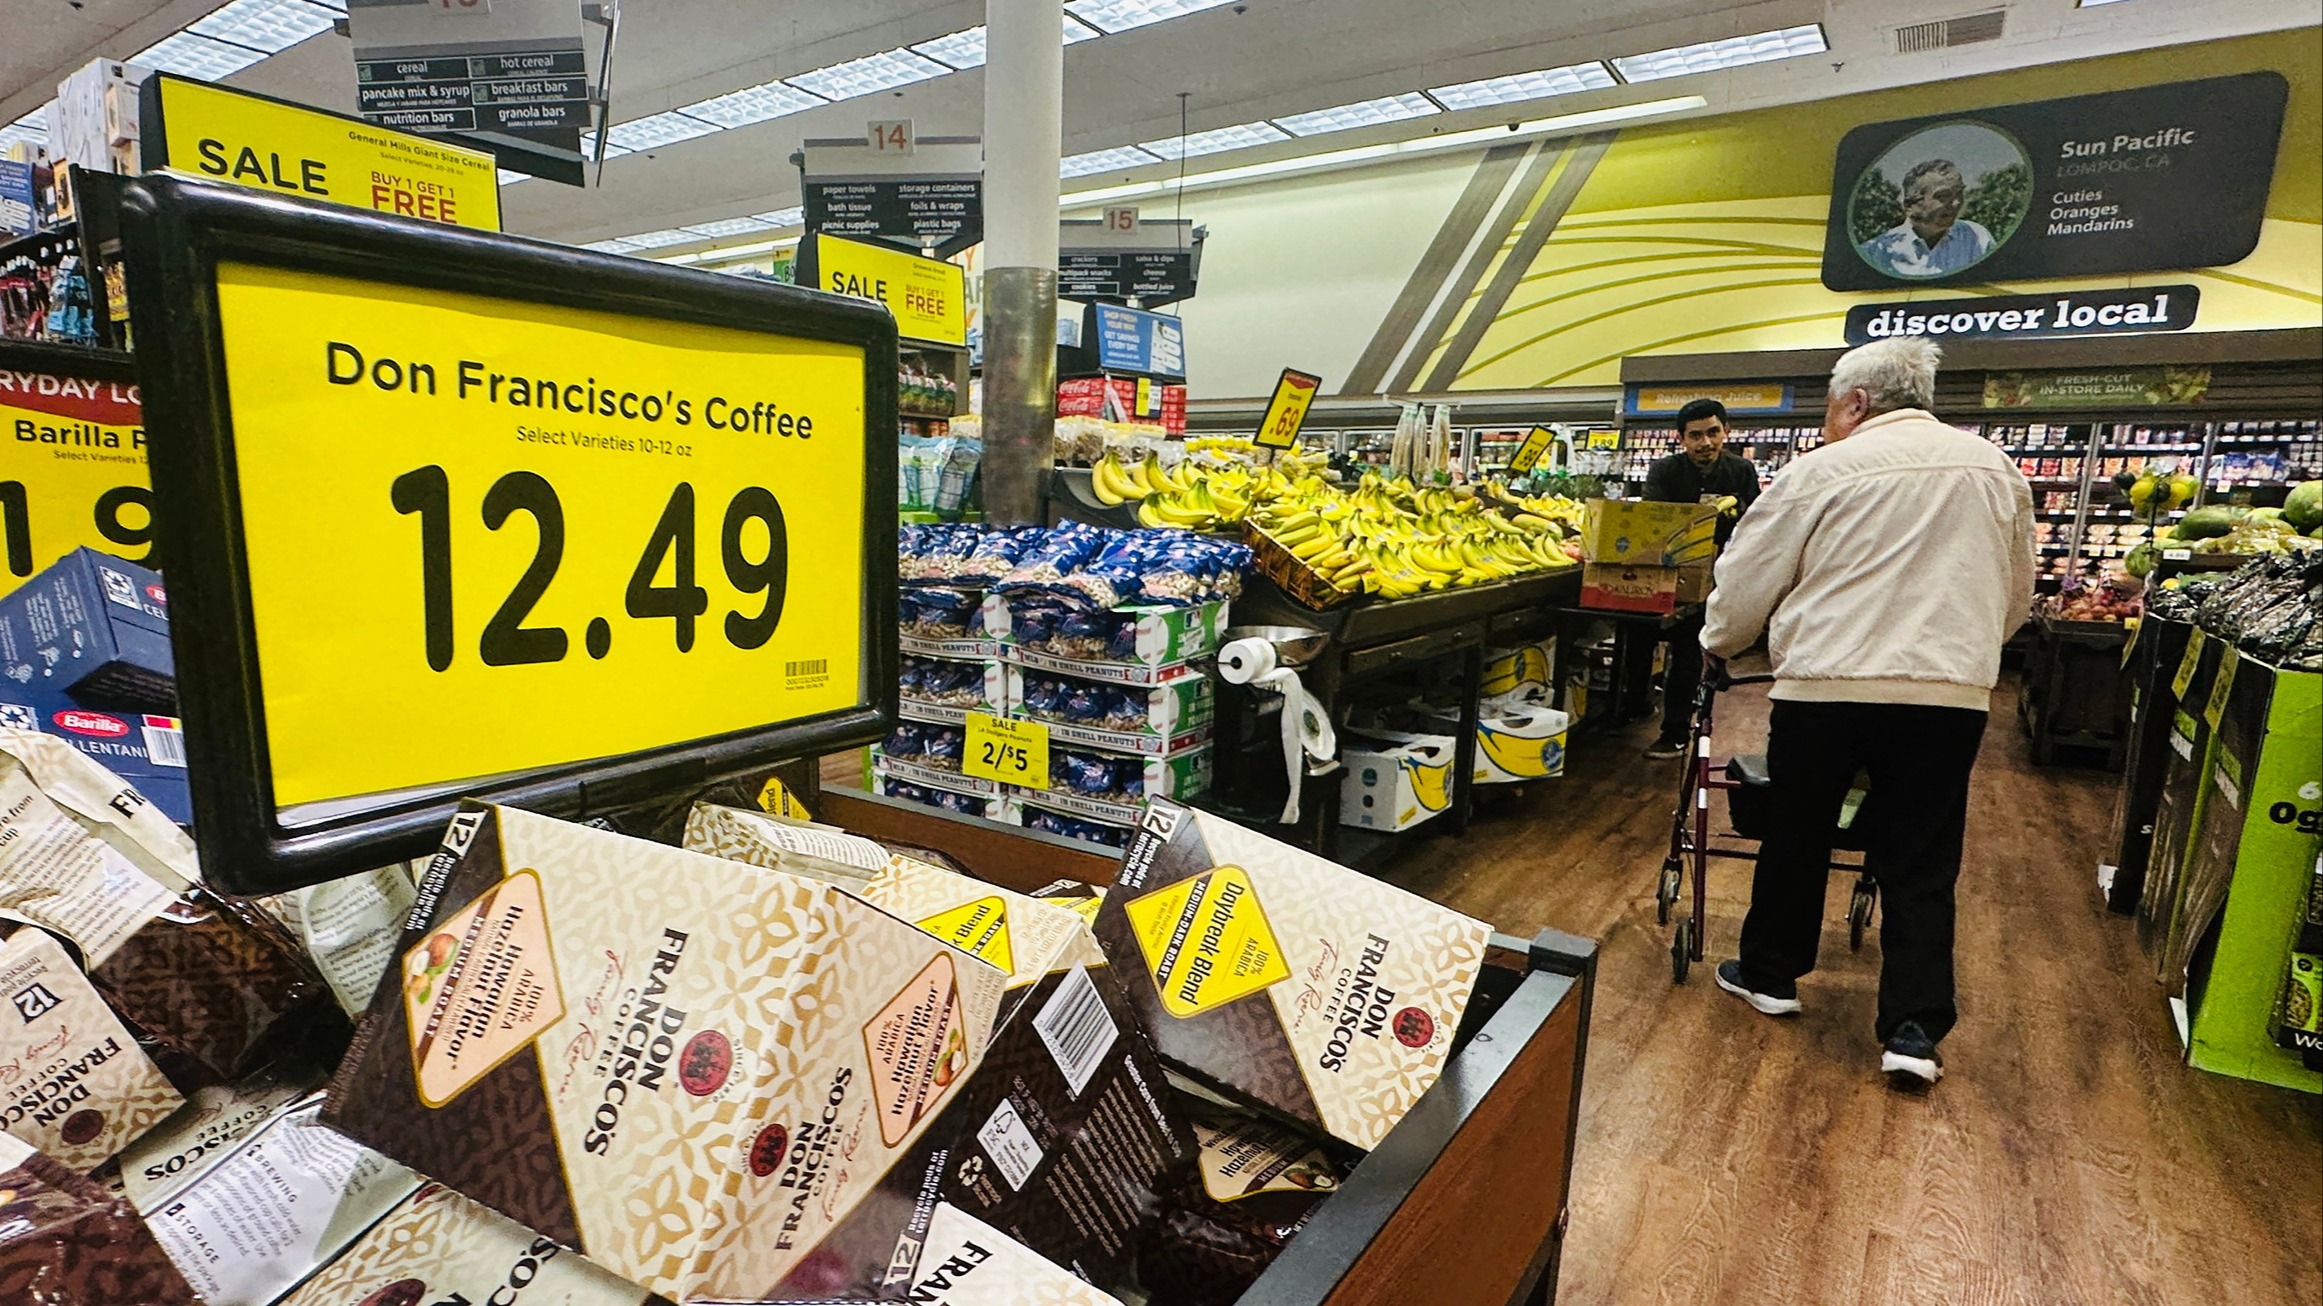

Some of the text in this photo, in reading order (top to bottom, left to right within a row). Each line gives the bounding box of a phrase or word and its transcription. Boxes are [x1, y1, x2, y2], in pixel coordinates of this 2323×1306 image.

[396, 60, 429, 74] cereal
[500, 54, 555, 69] hot cereal
[362, 85, 471, 102] pancake mix & syrup
[491, 80, 569, 95] breakfast bars
[383, 110, 455, 125] nutrition bars
[498, 105, 566, 122] granola bars
[348, 131, 490, 171] General Mills Giant Size Cereal
[873, 123, 907, 150] 14
[2060, 127, 2196, 158] Sun Pacific
[198, 138, 330, 196] SALE
[380, 151, 402, 162] Select
[2144, 154, 2171, 172] CA
[371, 171, 455, 199] BUY 1 GET 1
[822, 186, 847, 197] paper
[848, 184, 876, 194] towels
[898, 183, 975, 194] storage containers
[2052, 188, 2103, 205] Cuties
[371, 185, 458, 224] FREE
[827, 202, 873, 213] bath tissue
[910, 201, 965, 212] foils wraps
[2049, 202, 2119, 221] Oranges
[821, 219, 880, 231] picnic supplies
[913, 219, 962, 231] plastic bags
[1108, 210, 1133, 231] 15
[2047, 217, 2135, 236] Mandarins
[832, 271, 887, 302] SALE
[905, 284, 940, 298] BUY GET
[905, 293, 945, 316] FREE
[1866, 294, 2169, 338] discover local
[325, 340, 814, 441] Don Francisco's Coffee
[2039, 383, 2146, 395] IN-STORE DAILY
[2056, 373, 2133, 385] FRESH-CUT
[1724, 390, 1763, 402] Juice
[14, 419, 120, 449] Barilla
[1268, 406, 1300, 437] .69
[516, 424, 693, 457] Select Varieties 10-12 oz
[54, 449, 137, 465] Select Varieties
[390, 463, 789, 673] 12.49
[942, 644, 976, 653] PEANUTS
[1059, 661, 1084, 674] SHELL
[1085, 666, 1124, 678] PEANUTS
[64, 714, 123, 735] Barilla
[991, 718, 1017, 732] SALE
[1072, 730, 1136, 748] SHELL PEANUTS
[981, 741, 1029, 772] 2/$5
[920, 769, 973, 787] SHELL PEANUTS
[8, 793, 35, 818] from
[1069, 798, 1132, 820] SHELL PEANUTS
[446, 816, 478, 848] 12
[1149, 807, 1177, 840] 12
[1142, 837, 1162, 866] Recycle
[955, 903, 992, 940] Blend
[449, 914, 486, 980] MEDIUM
[475, 904, 525, 992] Hazelnut
[1178, 880, 1246, 1006] Daybreak Blend
[1233, 936, 1260, 979] ARABICA
[1157, 944, 1180, 980] ROAST
[1250, 949, 1270, 977] 100%
[15, 986, 57, 1018] 12
[471, 943, 524, 1040] Hawaiian
[500, 967, 536, 1031] ARABICA
[518, 983, 545, 1024] 100%
[1319, 932, 1391, 1074] FRANCISCO'S
[1322, 967, 1352, 1024] COFFEE
[426, 984, 454, 1036] ROAST
[1359, 985, 1396, 1041] DON
[584, 927, 690, 1157] FRANCISCO'S
[593, 986, 637, 1079] COFFEE
[876, 1020, 893, 1052] 100%
[882, 1013, 905, 1065] ARABICA
[890, 1004, 923, 1083] Hawaiian
[637, 1006, 688, 1093] DON
[8, 1057, 68, 1101] COFFEE
[891, 1042, 923, 1116] Hazelnut
[33, 1083, 92, 1128] DON
[774, 1066, 853, 1251] FRANCISCO'S
[780, 1120, 816, 1190] DON
[812, 1122, 845, 1198] COFFEE
[1258, 1158, 1291, 1183] MEDIUM
[254, 1153, 298, 1203] BREWING
[175, 1213, 220, 1264] STORAGE
[890, 1239, 919, 1278] 12
